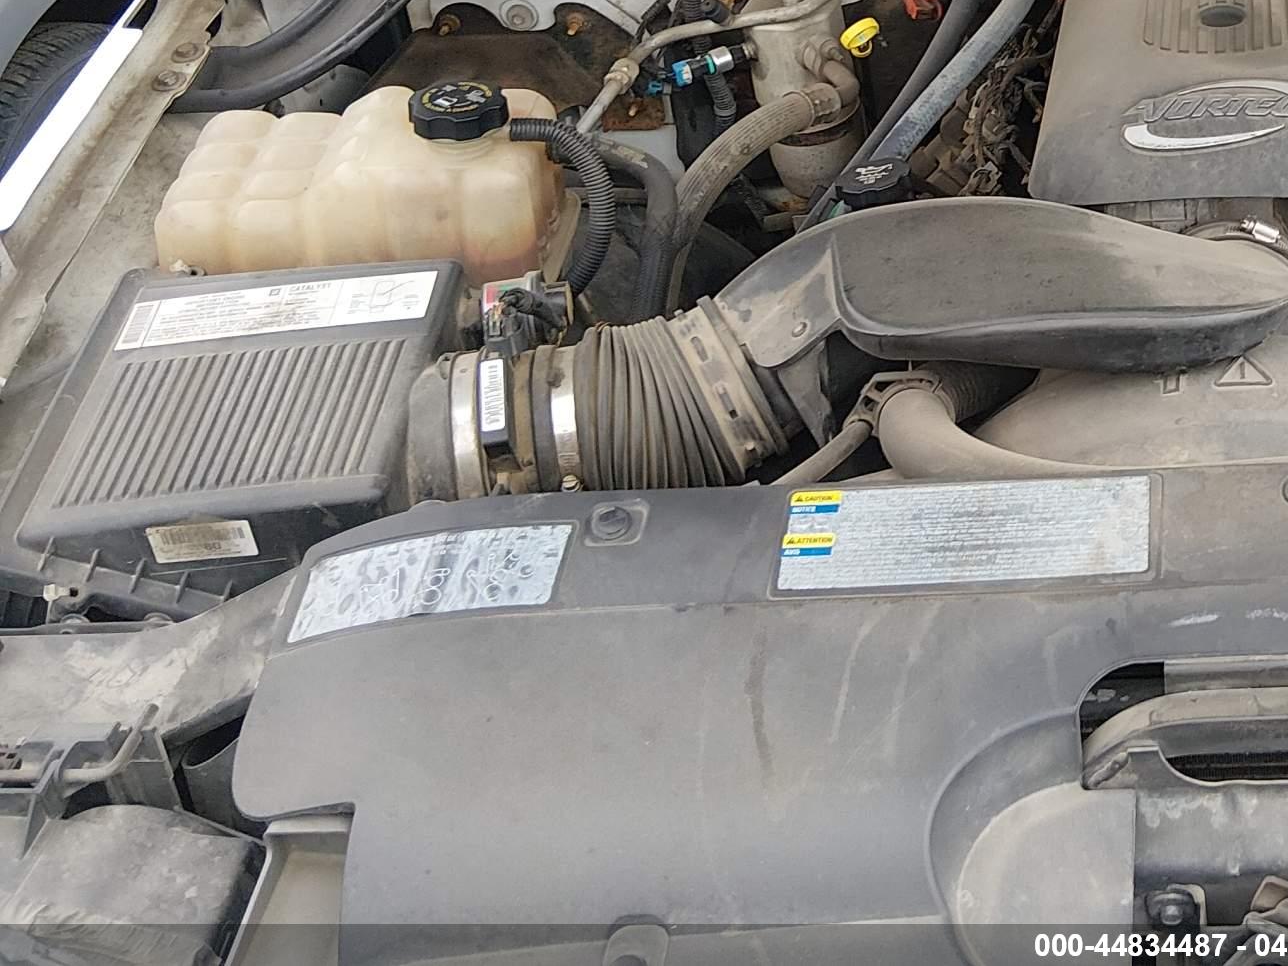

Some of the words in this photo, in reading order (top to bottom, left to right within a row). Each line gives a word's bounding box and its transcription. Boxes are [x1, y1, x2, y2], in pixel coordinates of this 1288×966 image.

[290, 282, 332, 294] CATALYST
[804, 495, 833, 503] CAUTION
[796, 537, 833, 545] ATTENTION
